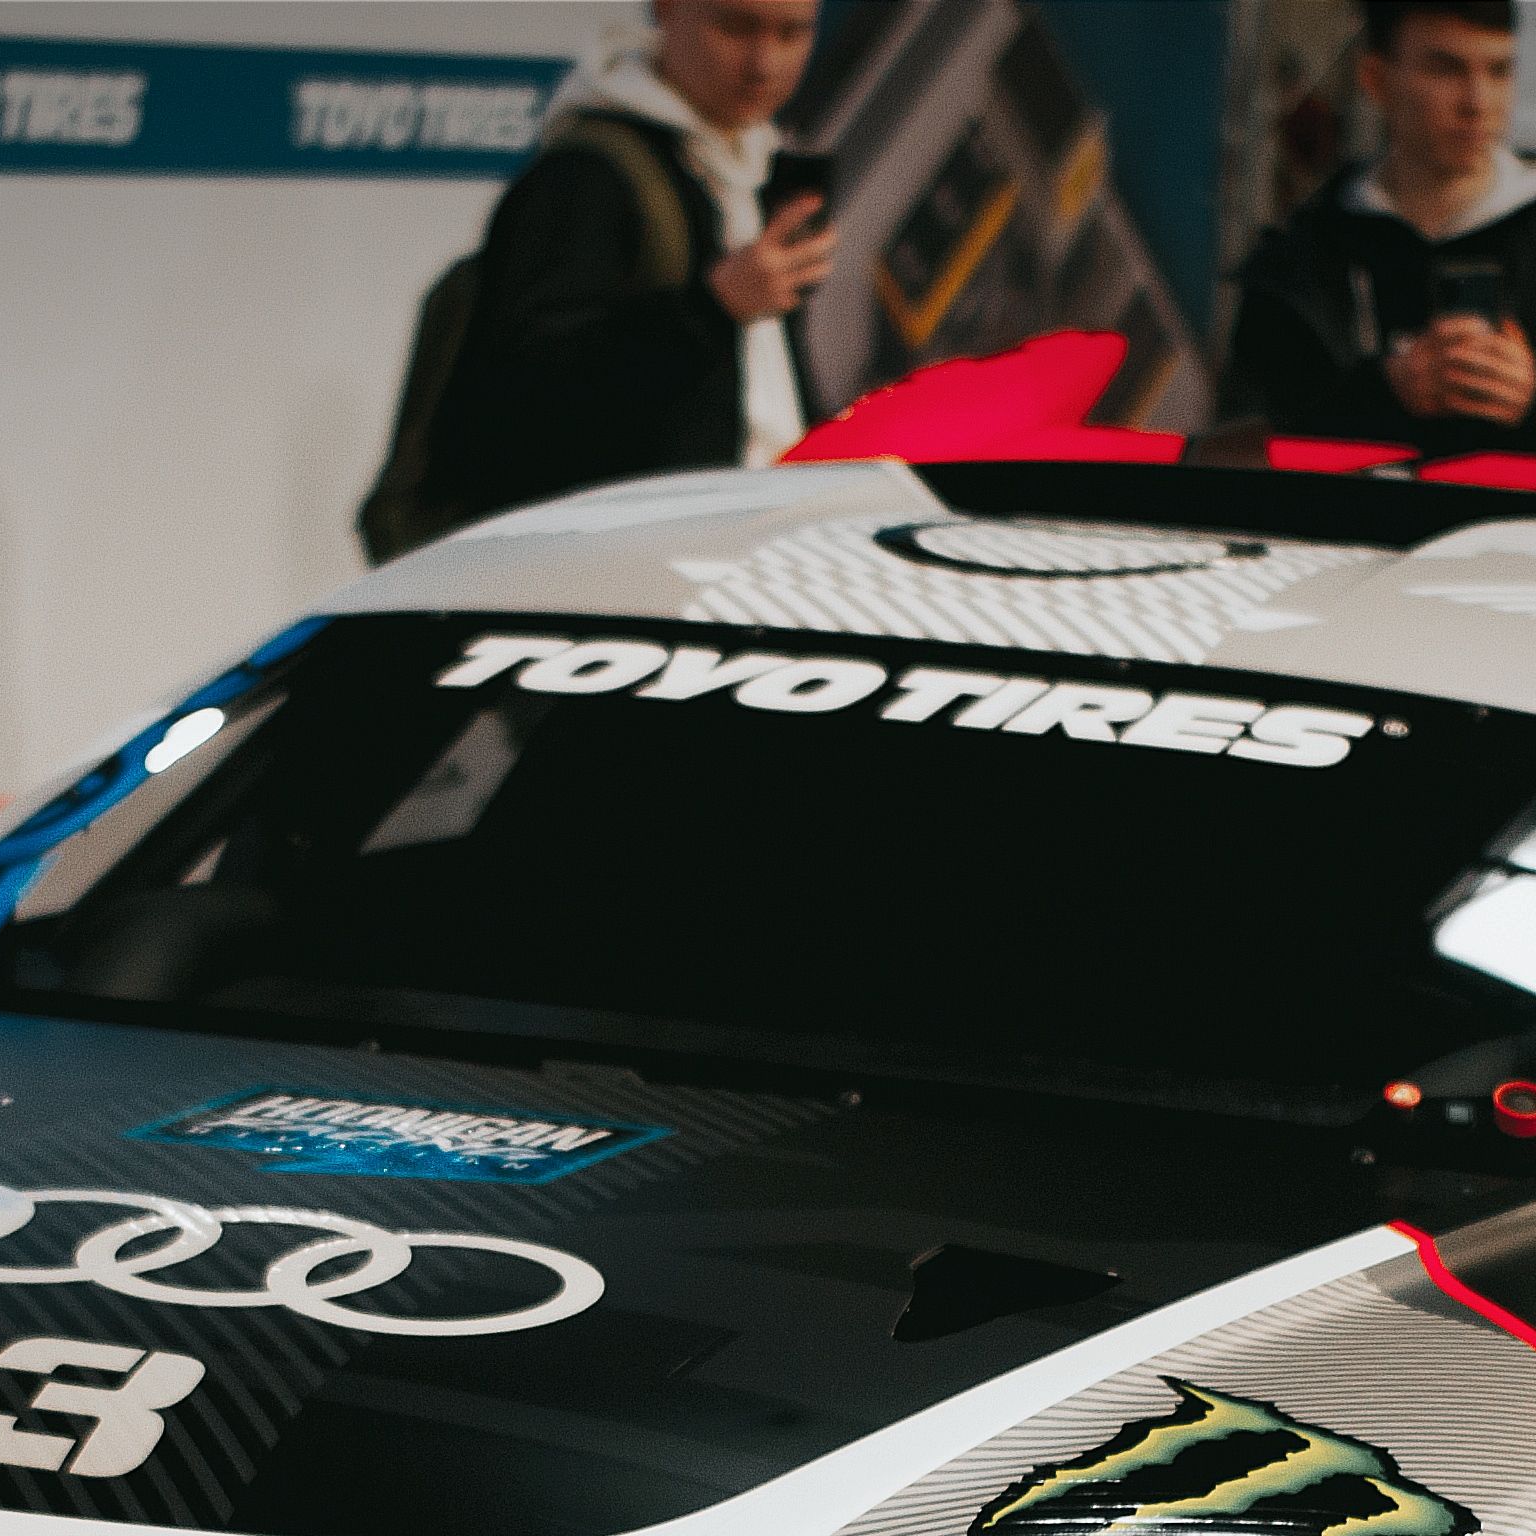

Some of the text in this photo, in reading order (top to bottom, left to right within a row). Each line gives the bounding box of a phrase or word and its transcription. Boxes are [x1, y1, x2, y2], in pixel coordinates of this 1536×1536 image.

[0, 73, 146, 146] TIRES
[292, 80, 415, 149] TOYO
[437, 635, 1375, 768] TOYO TIRES
[232, 1094, 614, 1153] HOONIGAN
